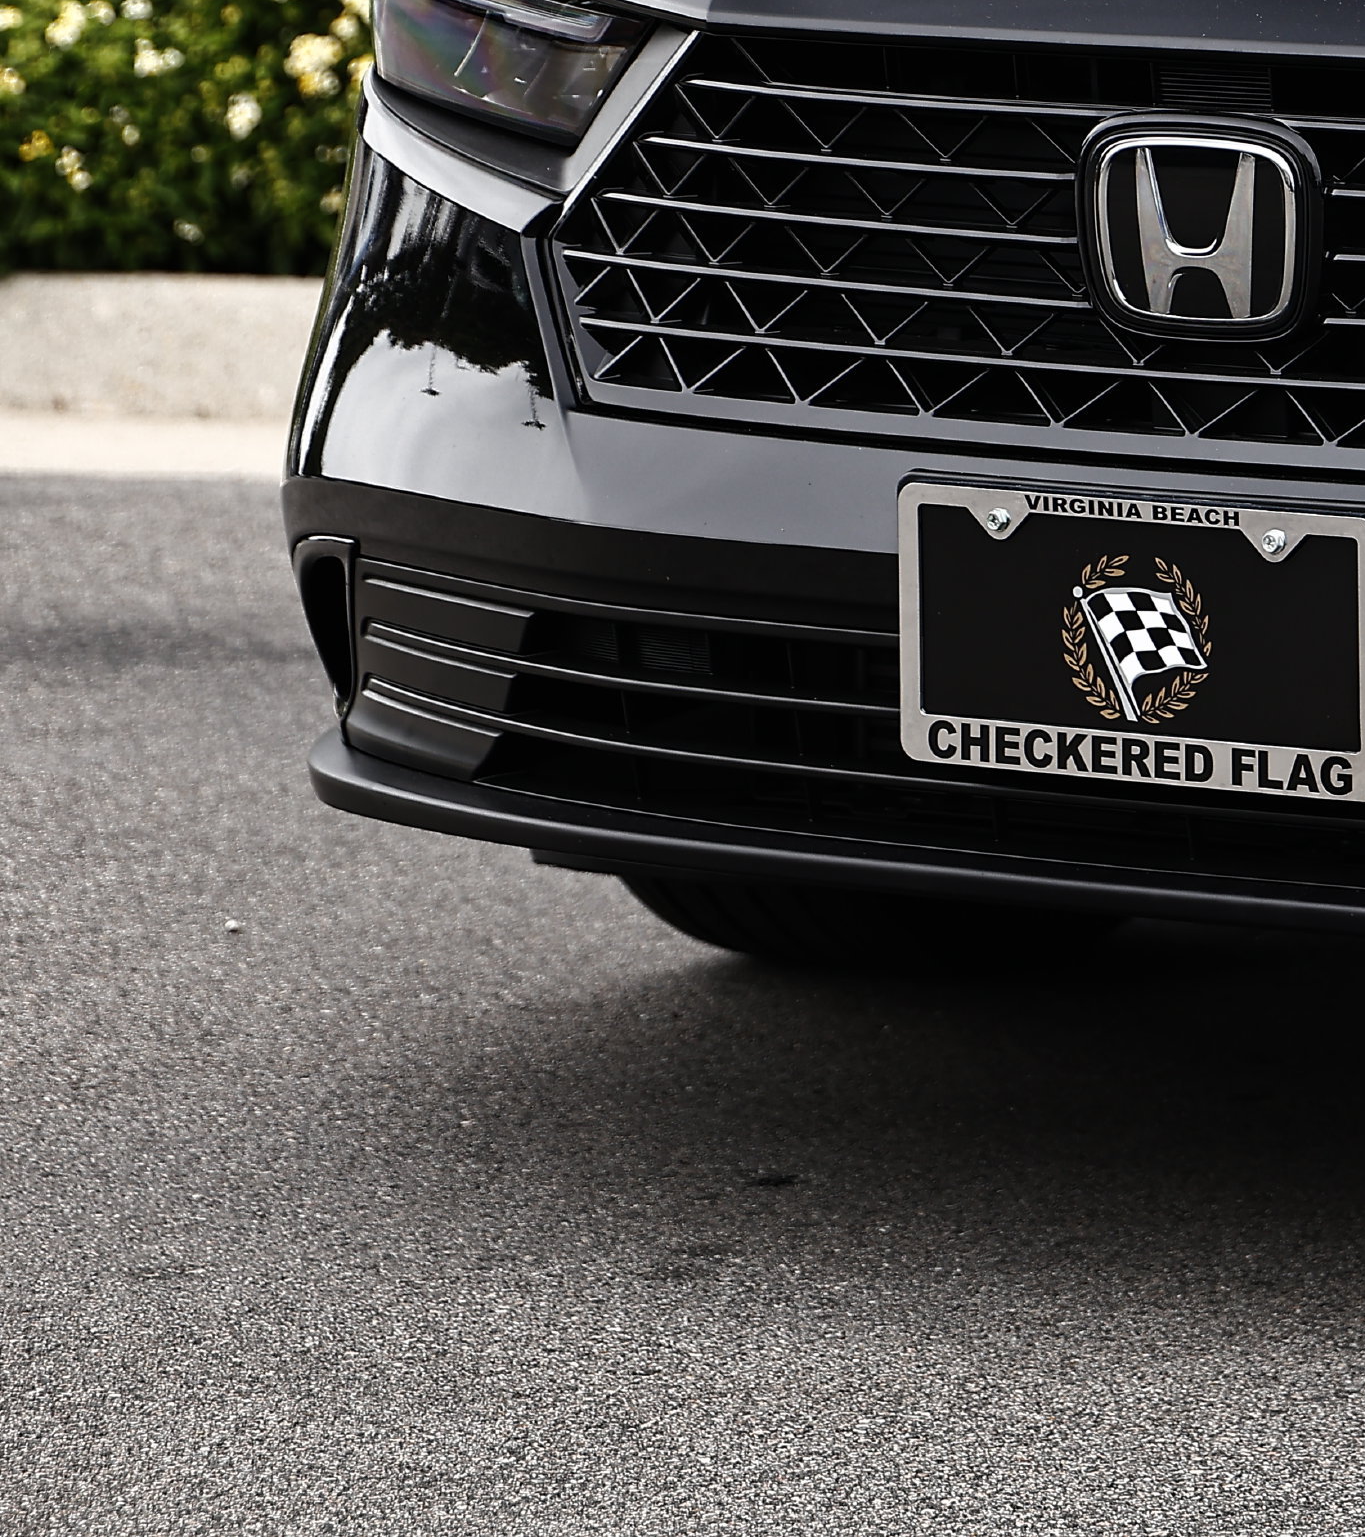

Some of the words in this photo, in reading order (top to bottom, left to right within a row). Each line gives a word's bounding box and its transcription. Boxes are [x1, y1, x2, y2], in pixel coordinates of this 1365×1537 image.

[1024, 494, 1143, 519] VIRGINIA
[1152, 504, 1240, 527] BEACH
[927, 719, 1214, 783] CHECKERED
[1231, 747, 1354, 795] FLAG
